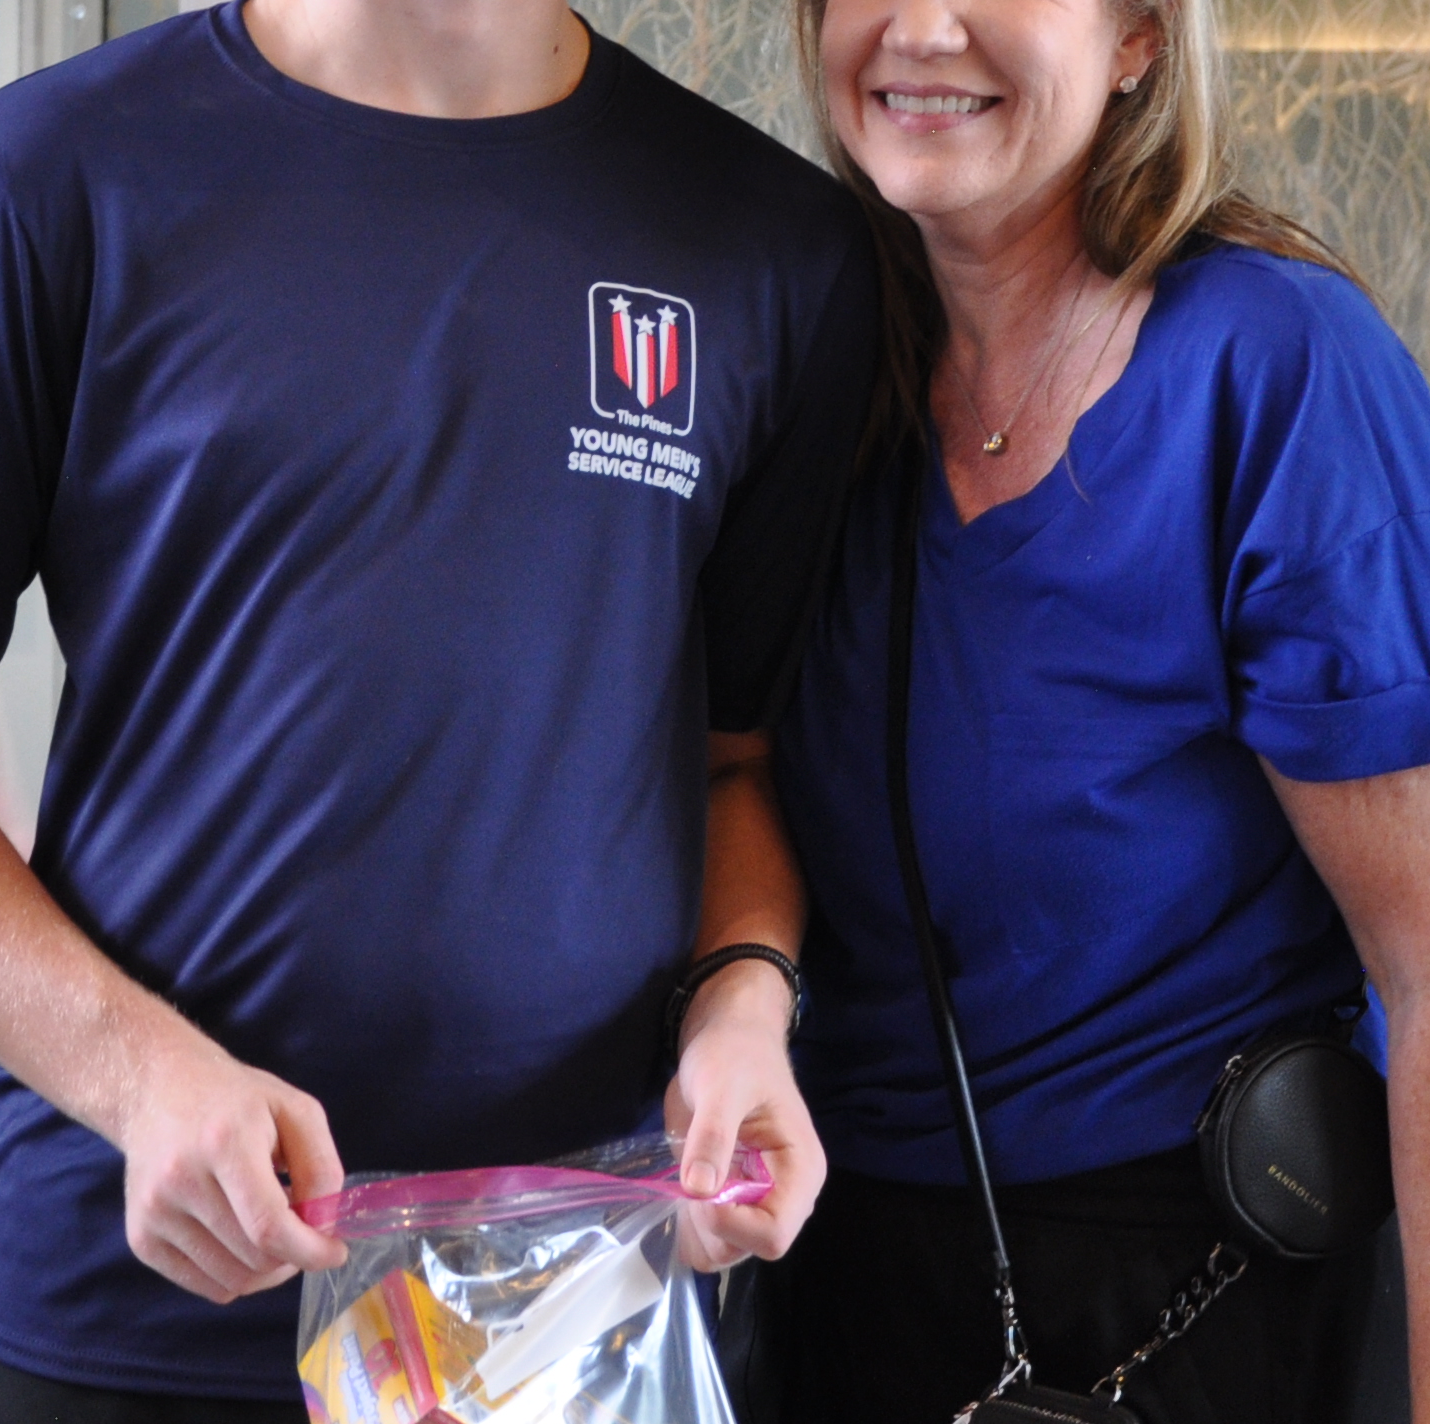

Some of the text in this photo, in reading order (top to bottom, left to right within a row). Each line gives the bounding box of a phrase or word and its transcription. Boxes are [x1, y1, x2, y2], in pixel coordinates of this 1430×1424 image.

[617, 409, 673, 435] The Pines
[568, 451, 696, 499] SERVICE LEAGUE
[570, 427, 701, 478] YOUNG MEN'S
